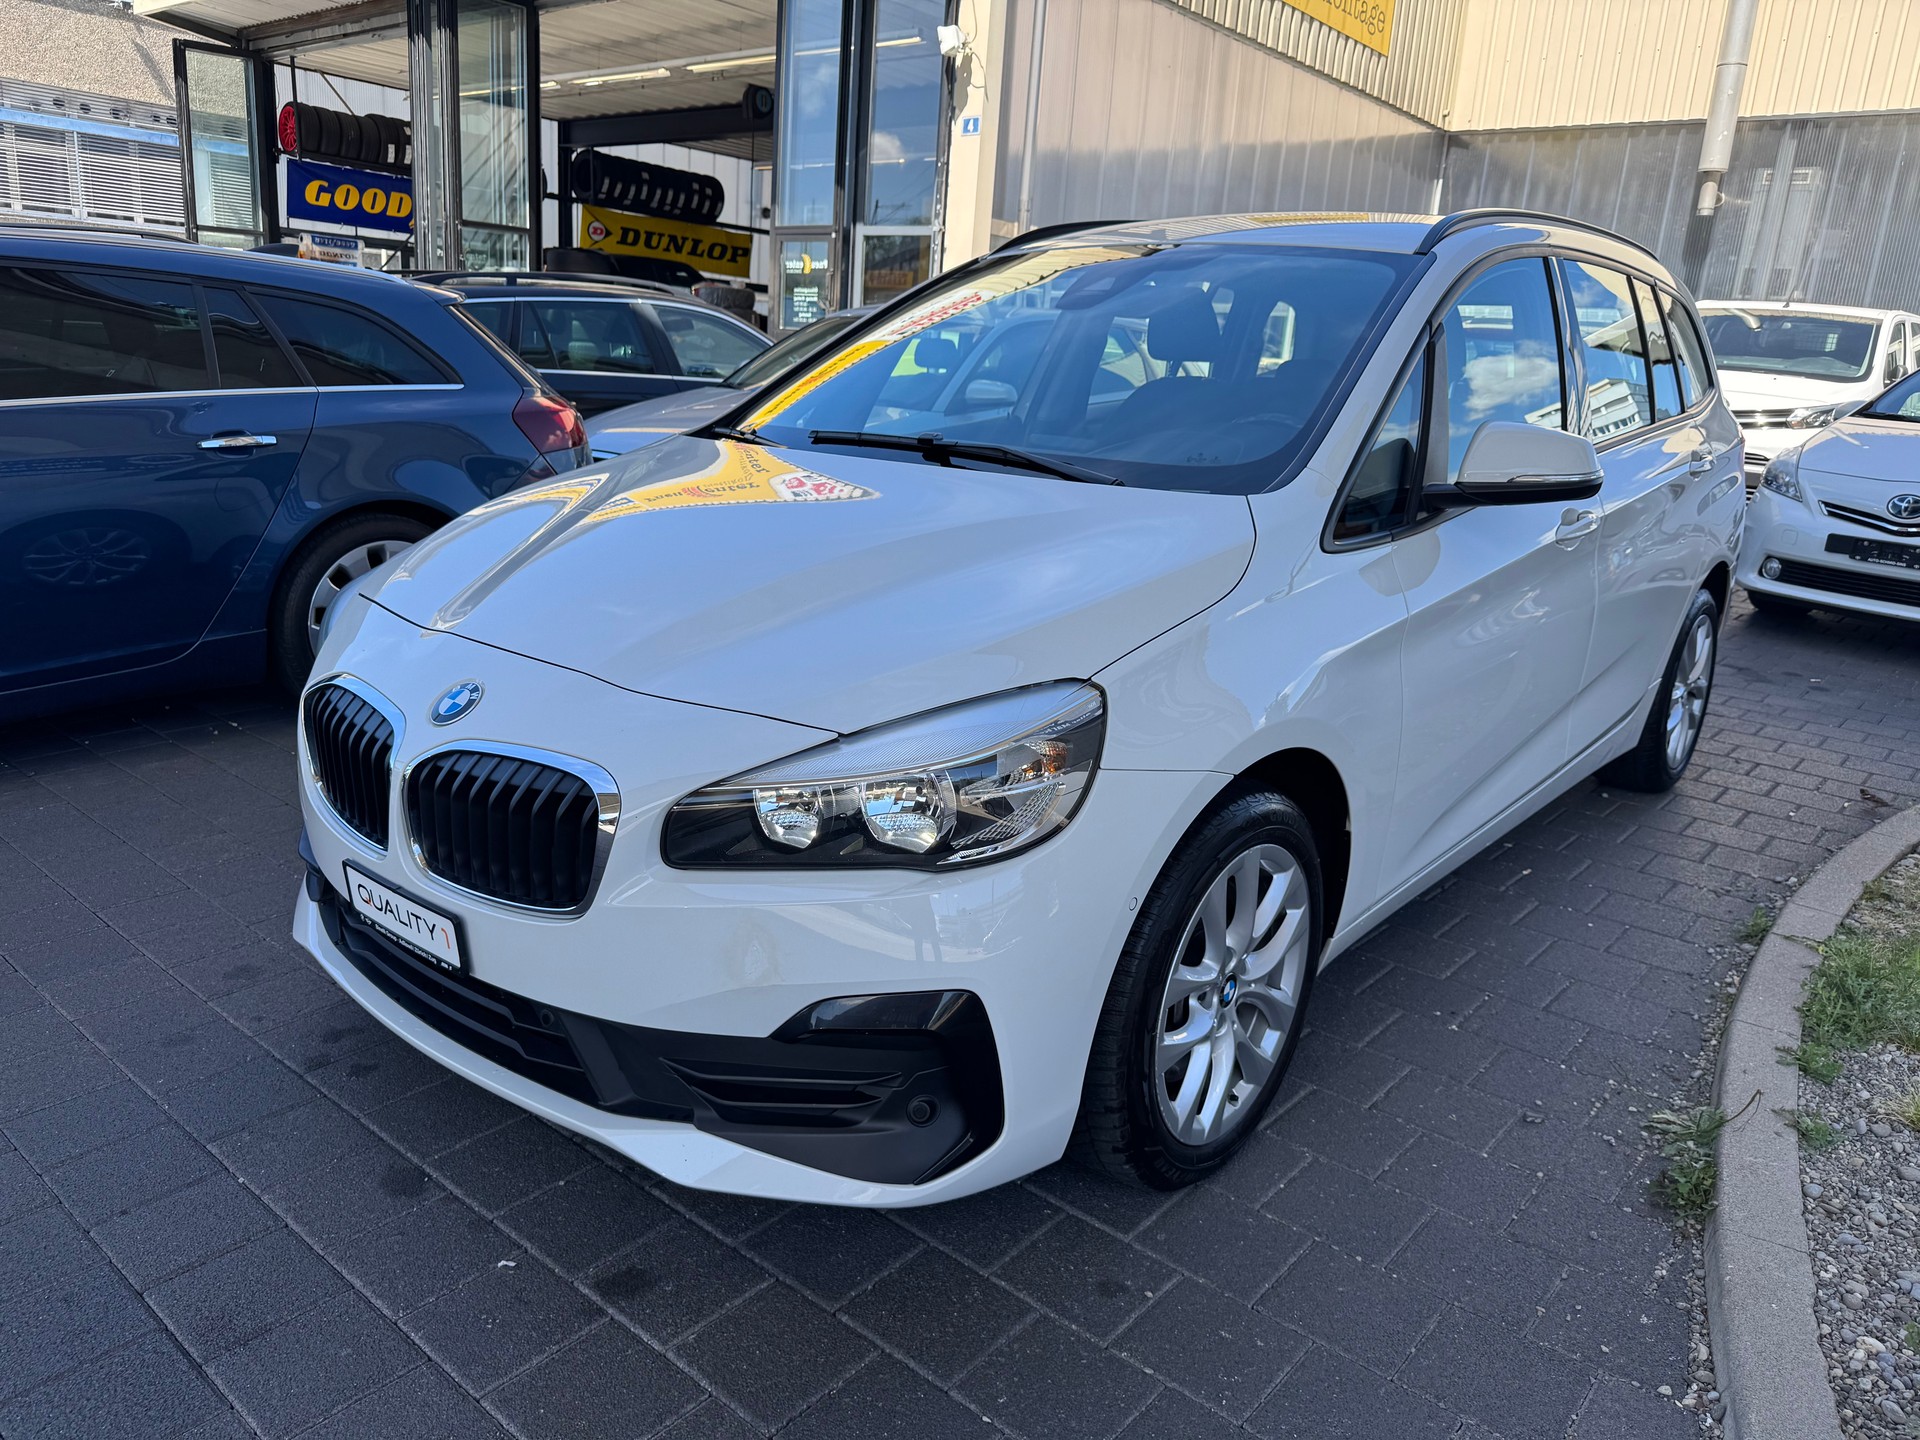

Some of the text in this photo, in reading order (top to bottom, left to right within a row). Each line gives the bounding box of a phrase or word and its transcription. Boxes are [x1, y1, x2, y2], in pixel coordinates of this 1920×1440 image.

[967, 118, 974, 132] 4
[305, 180, 414, 228] GOOD
[616, 226, 749, 264] DUNLOP
[357, 883, 451, 950] QUALITY 1
